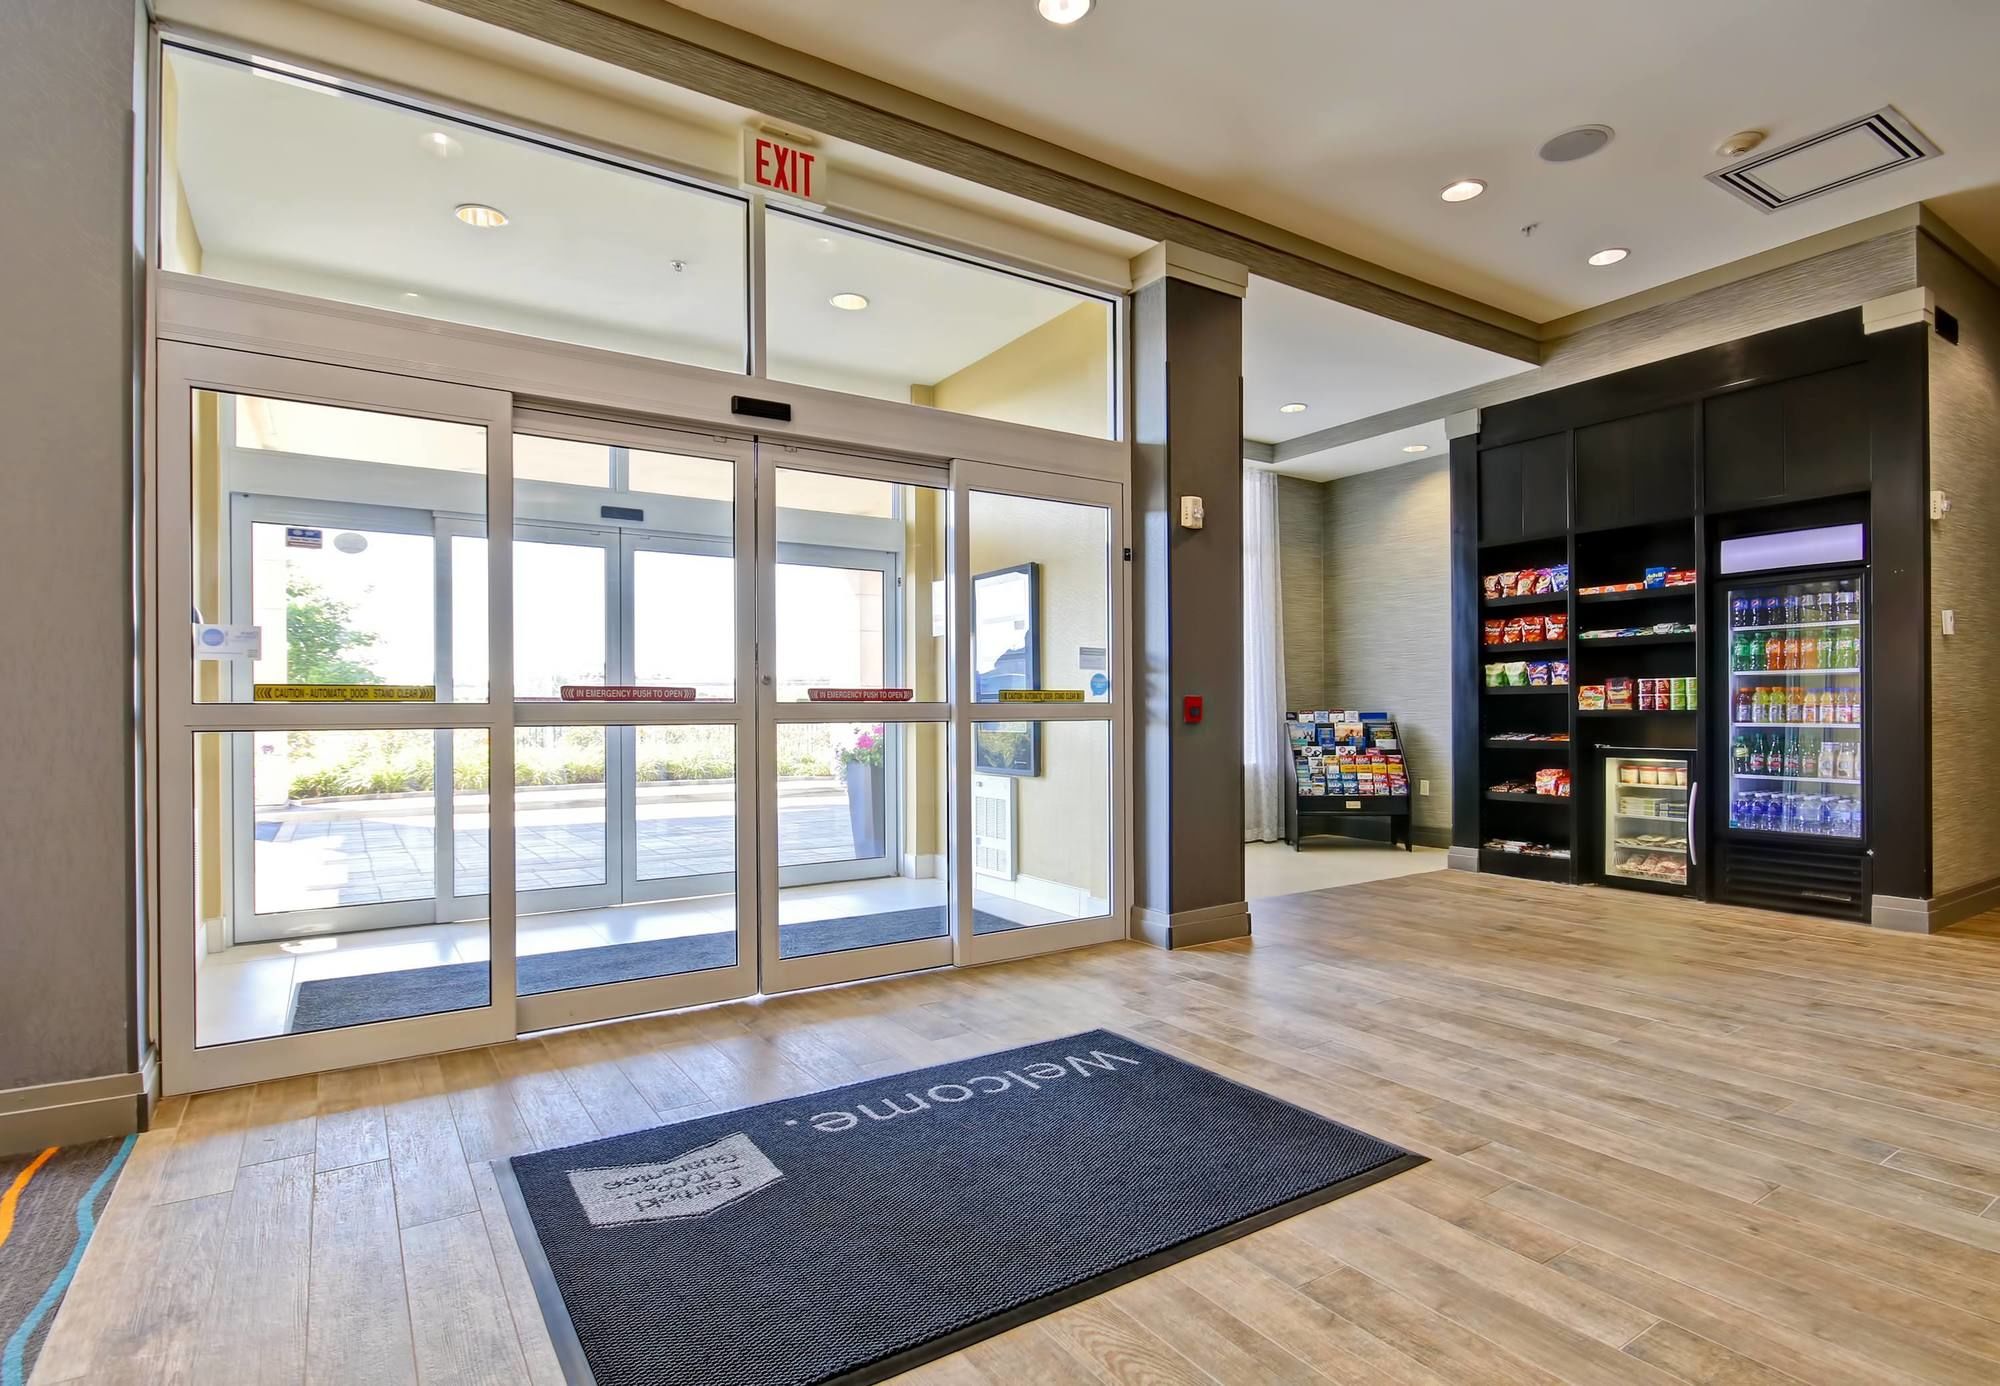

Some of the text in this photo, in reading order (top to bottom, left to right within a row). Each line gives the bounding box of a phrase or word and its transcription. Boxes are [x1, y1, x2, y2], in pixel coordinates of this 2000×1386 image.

[756, 138, 815, 198] EXIT
[275, 688, 304, 698] CAUTION
[310, 688, 347, 699] AUTOMATIC
[350, 688, 368, 699] DOOR
[373, 689, 394, 699] STAND
[397, 689, 418, 699] CLEAR
[585, 690, 631, 698] EMERGENCY
[633, 690, 652, 698] PUSH
[653, 690, 662, 698] TO
[827, 691, 862, 699] EMERGENCY
[863, 691, 879, 699] PUSH
[879, 691, 887, 699] TO
[887, 691, 903, 699] OPEN
[784, 1050, 1142, 1132] Welcome.
